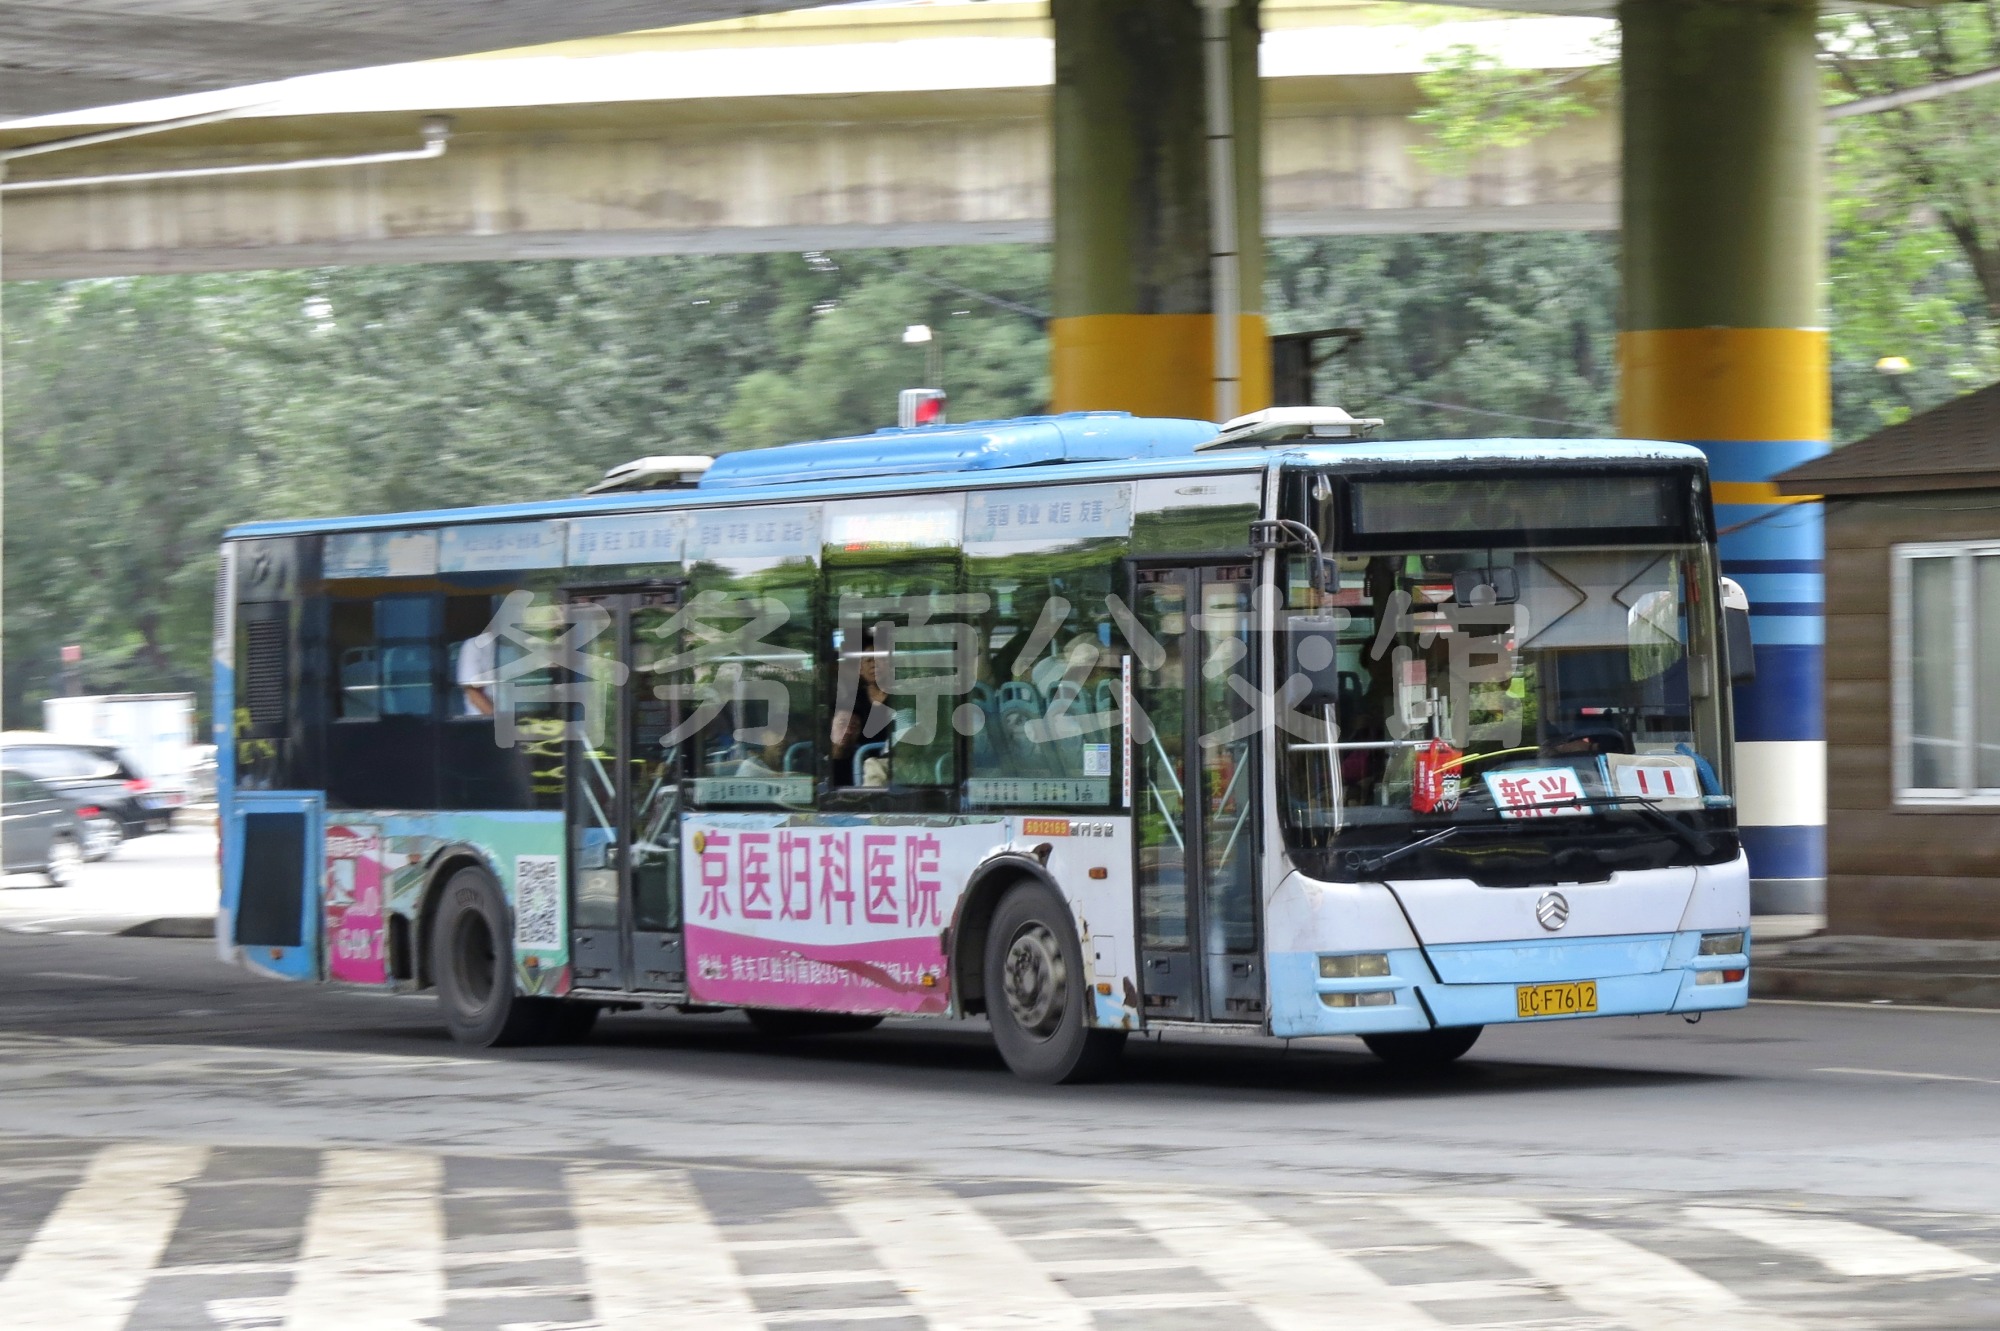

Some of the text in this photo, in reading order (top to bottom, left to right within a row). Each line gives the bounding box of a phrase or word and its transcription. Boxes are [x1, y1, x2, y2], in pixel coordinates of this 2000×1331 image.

[1498, 775, 1582, 818] 新兴
[698, 829, 943, 928] 京医妇科医院
